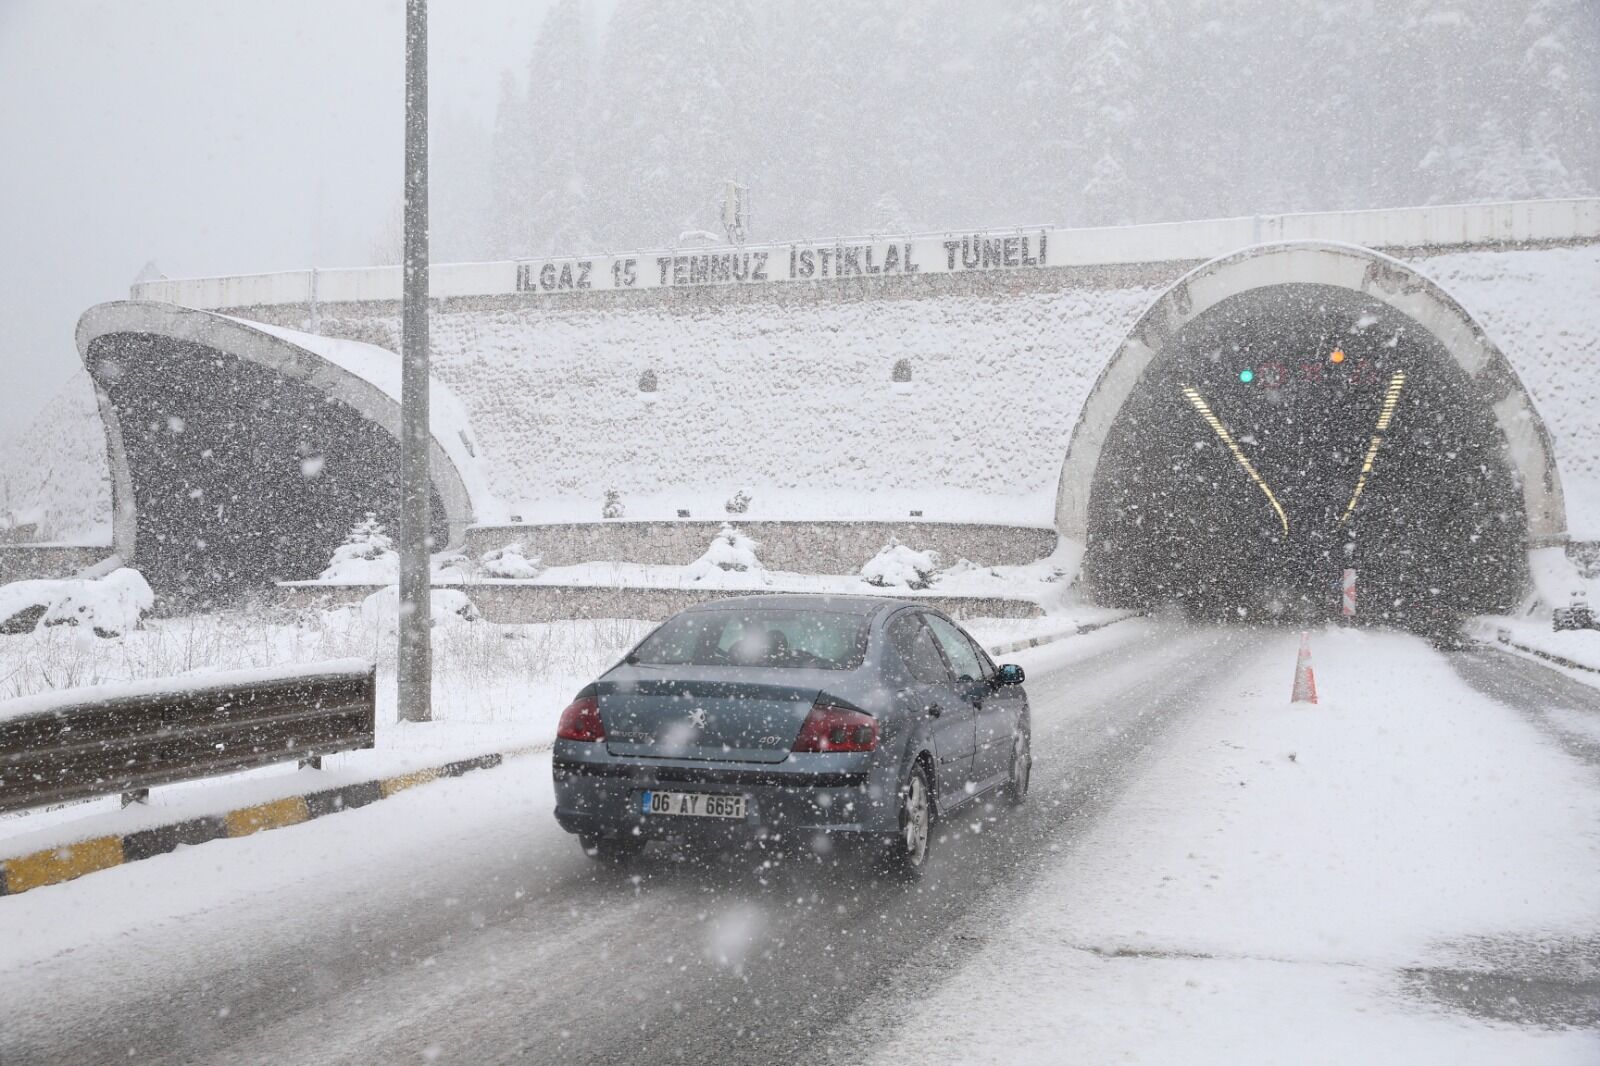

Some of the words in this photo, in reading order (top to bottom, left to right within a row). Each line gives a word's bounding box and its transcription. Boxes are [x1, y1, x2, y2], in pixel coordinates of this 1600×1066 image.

[516, 261, 592, 292] ILGAZ
[611, 258, 637, 288] 15
[656, 252, 769, 284] TEMMUZ
[943, 229, 1047, 269] TÜNELİ
[759, 736, 781, 745] 407
[652, 793, 670, 812] 06
[680, 794, 699, 814] AY
[706, 796, 741, 817] 6651
